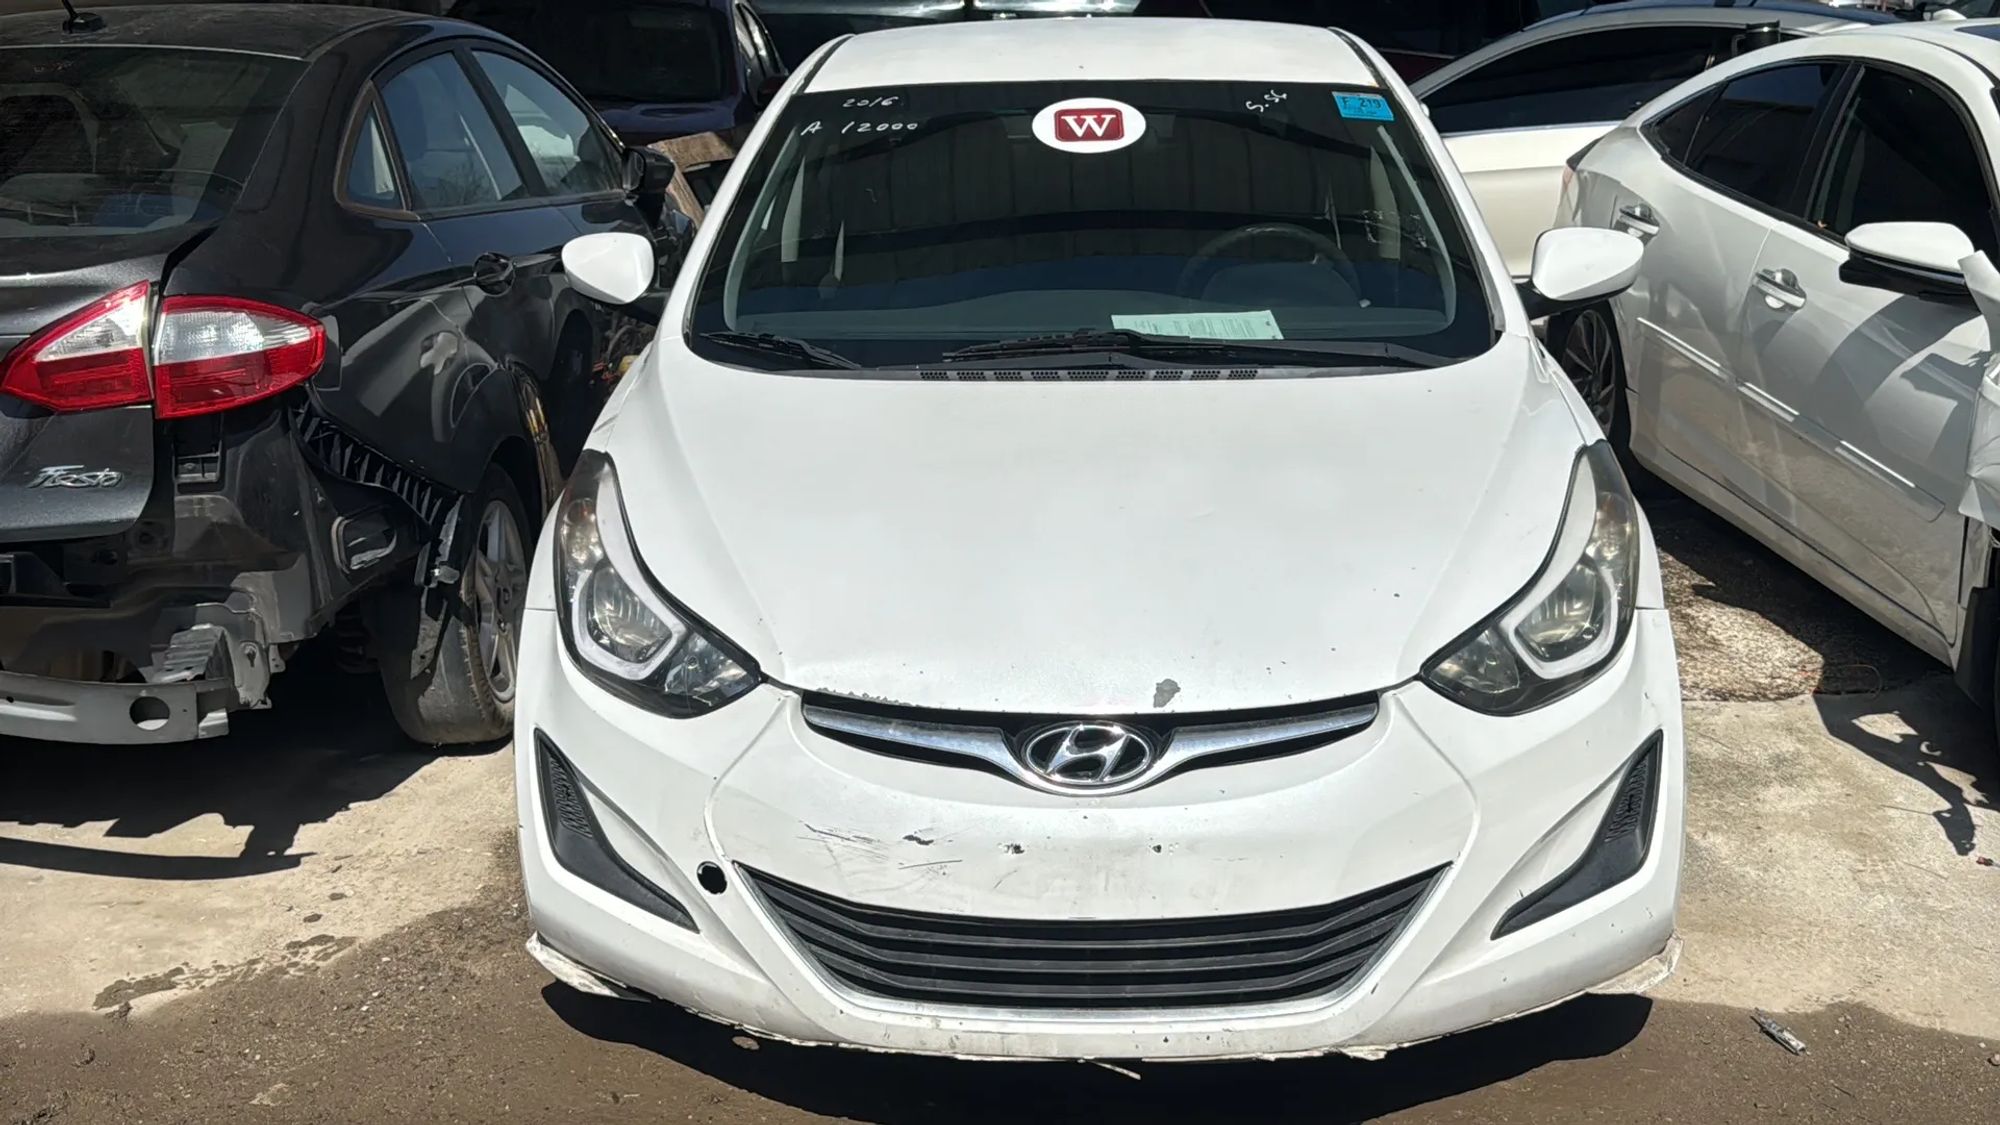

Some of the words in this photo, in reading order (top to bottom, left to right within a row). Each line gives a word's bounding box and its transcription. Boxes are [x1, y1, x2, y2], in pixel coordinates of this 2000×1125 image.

[842, 95, 900, 108] 2016
[841, 121, 919, 135] 12000
[1060, 114, 1117, 138] W
[27, 464, 125, 488] Fiesta
